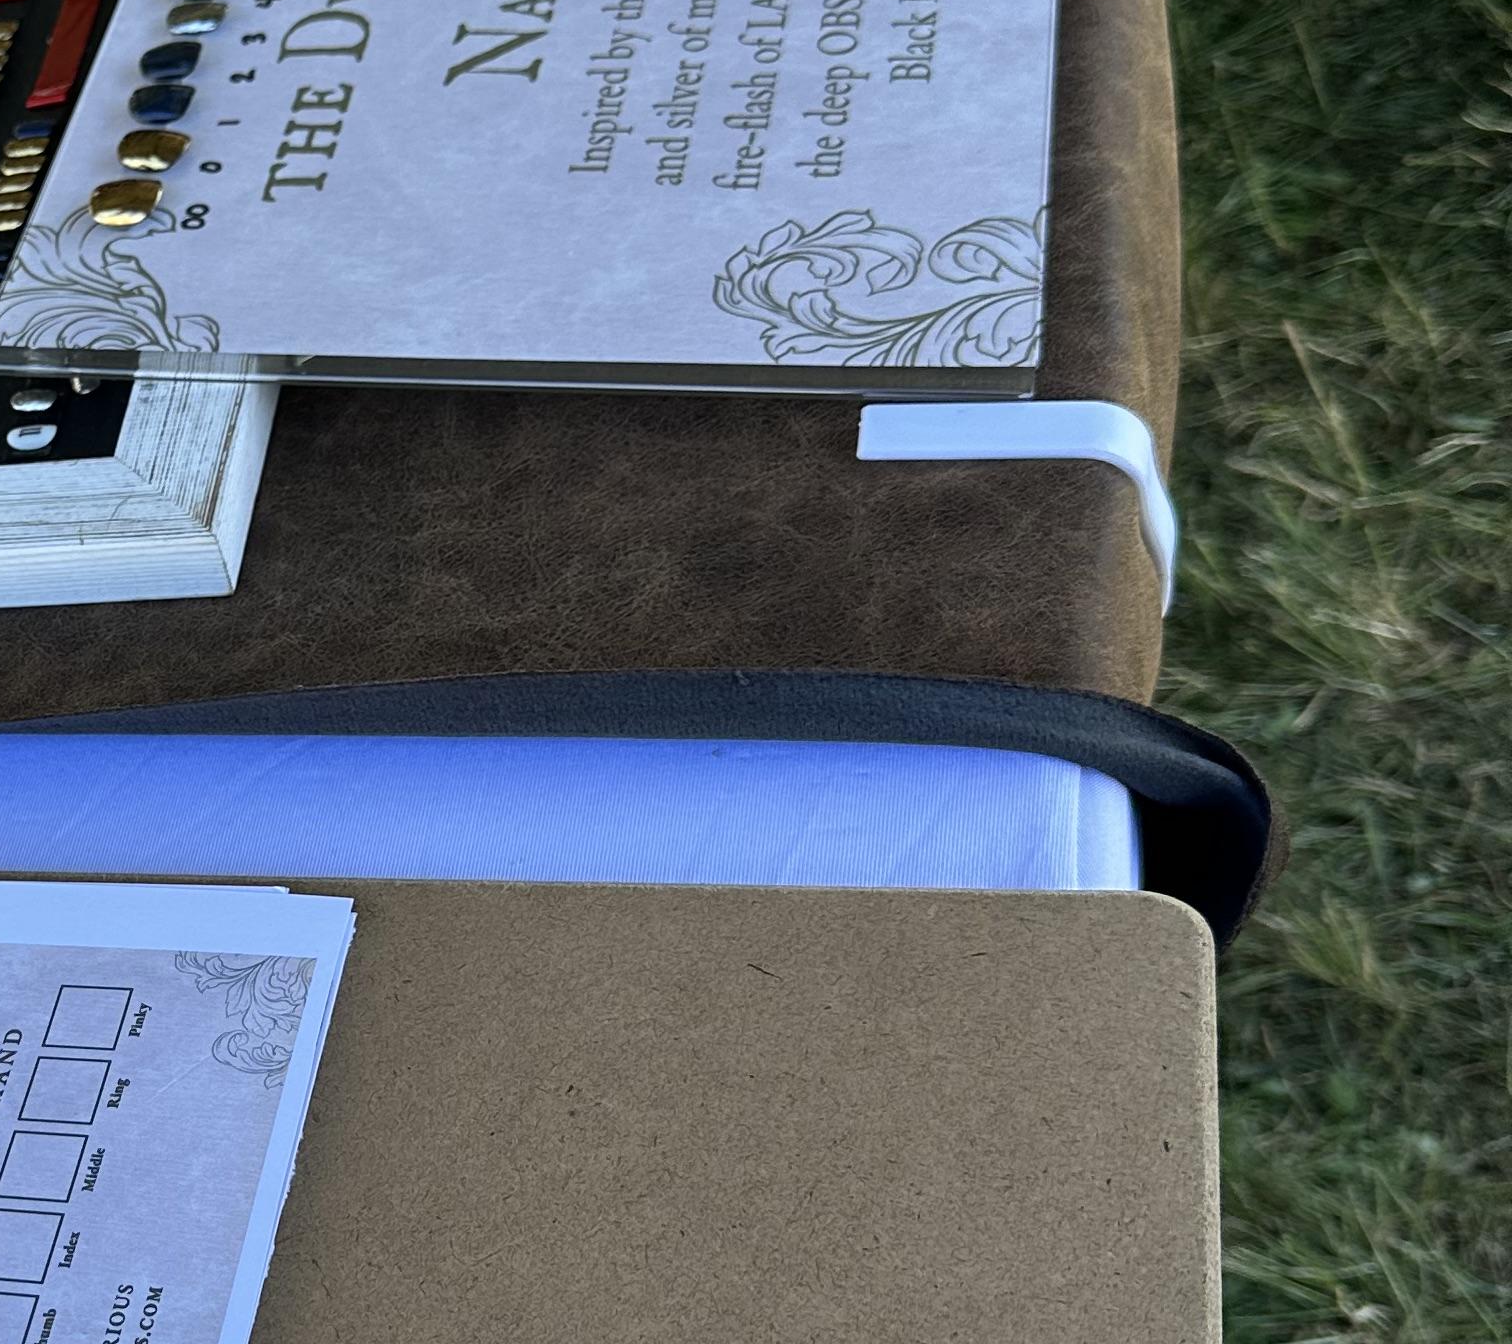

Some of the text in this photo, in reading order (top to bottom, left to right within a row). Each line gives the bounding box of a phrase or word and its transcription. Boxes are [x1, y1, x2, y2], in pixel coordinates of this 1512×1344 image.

[242, 33, 266, 45] 3
[589, 28, 653, 61] by
[668, 22, 707, 52] of
[738, 33, 779, 63] of
[885, 10, 940, 84] Black
[230, 70, 255, 84] 2
[651, 59, 707, 129] silver
[802, 64, 872, 126] deep
[262, 82, 354, 202] THE
[568, 67, 635, 174] Inspired
[712, 72, 780, 192] fire-flash
[199, 161, 222, 174] 0
[644, 136, 692, 186] and
[793, 135, 846, 179] the
[180, 203, 209, 230] 00
[57, 1231, 80, 1269] Index
[81, 1148, 105, 1192] Middle
[107, 1077, 130, 1109] Ring
[128, 1002, 152, 1038] Pinky
